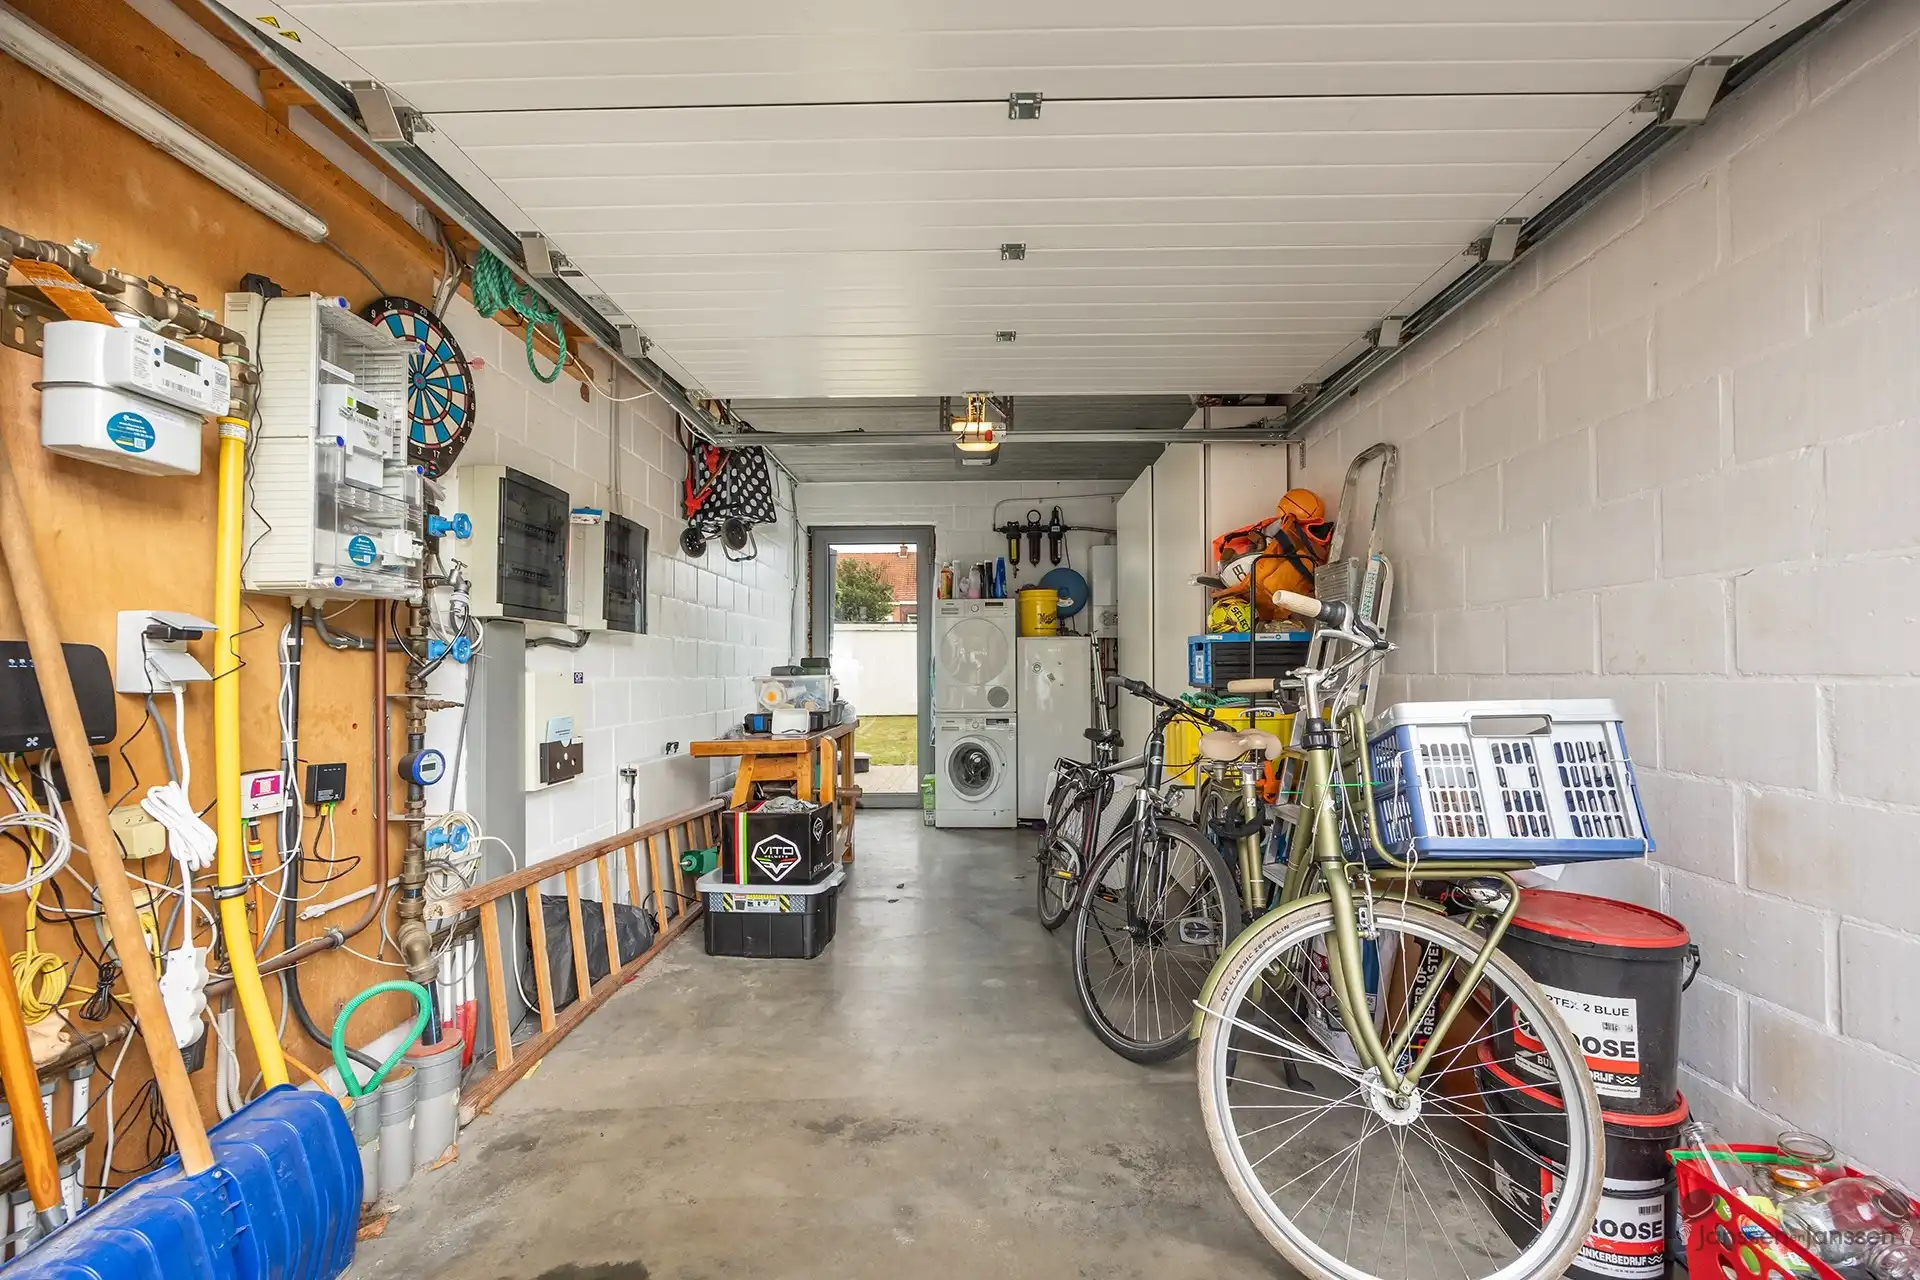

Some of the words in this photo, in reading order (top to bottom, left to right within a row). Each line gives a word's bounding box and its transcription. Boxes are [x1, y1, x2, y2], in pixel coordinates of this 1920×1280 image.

[384, 300, 392, 310] 12
[404, 301, 409, 309] 5
[371, 310, 376, 318] 9
[419, 306, 428, 317] 20
[438, 321, 442, 329] 1
[467, 420, 474, 429] 10
[460, 435, 467, 444] 15
[417, 447, 422, 455] 3
[433, 450, 440, 459] 17
[448, 446, 453, 454] 2
[1230, 606, 1250, 632] SELECT
[759, 846, 794, 855] VITO
[1220, 985, 1231, 1002] CST
[1229, 953, 1254, 986] CLASSIC
[1253, 924, 1290, 953] ZEPPELIN
[1582, 1003, 1590, 1013] 2
[1594, 1005, 1629, 1017] BLUE
